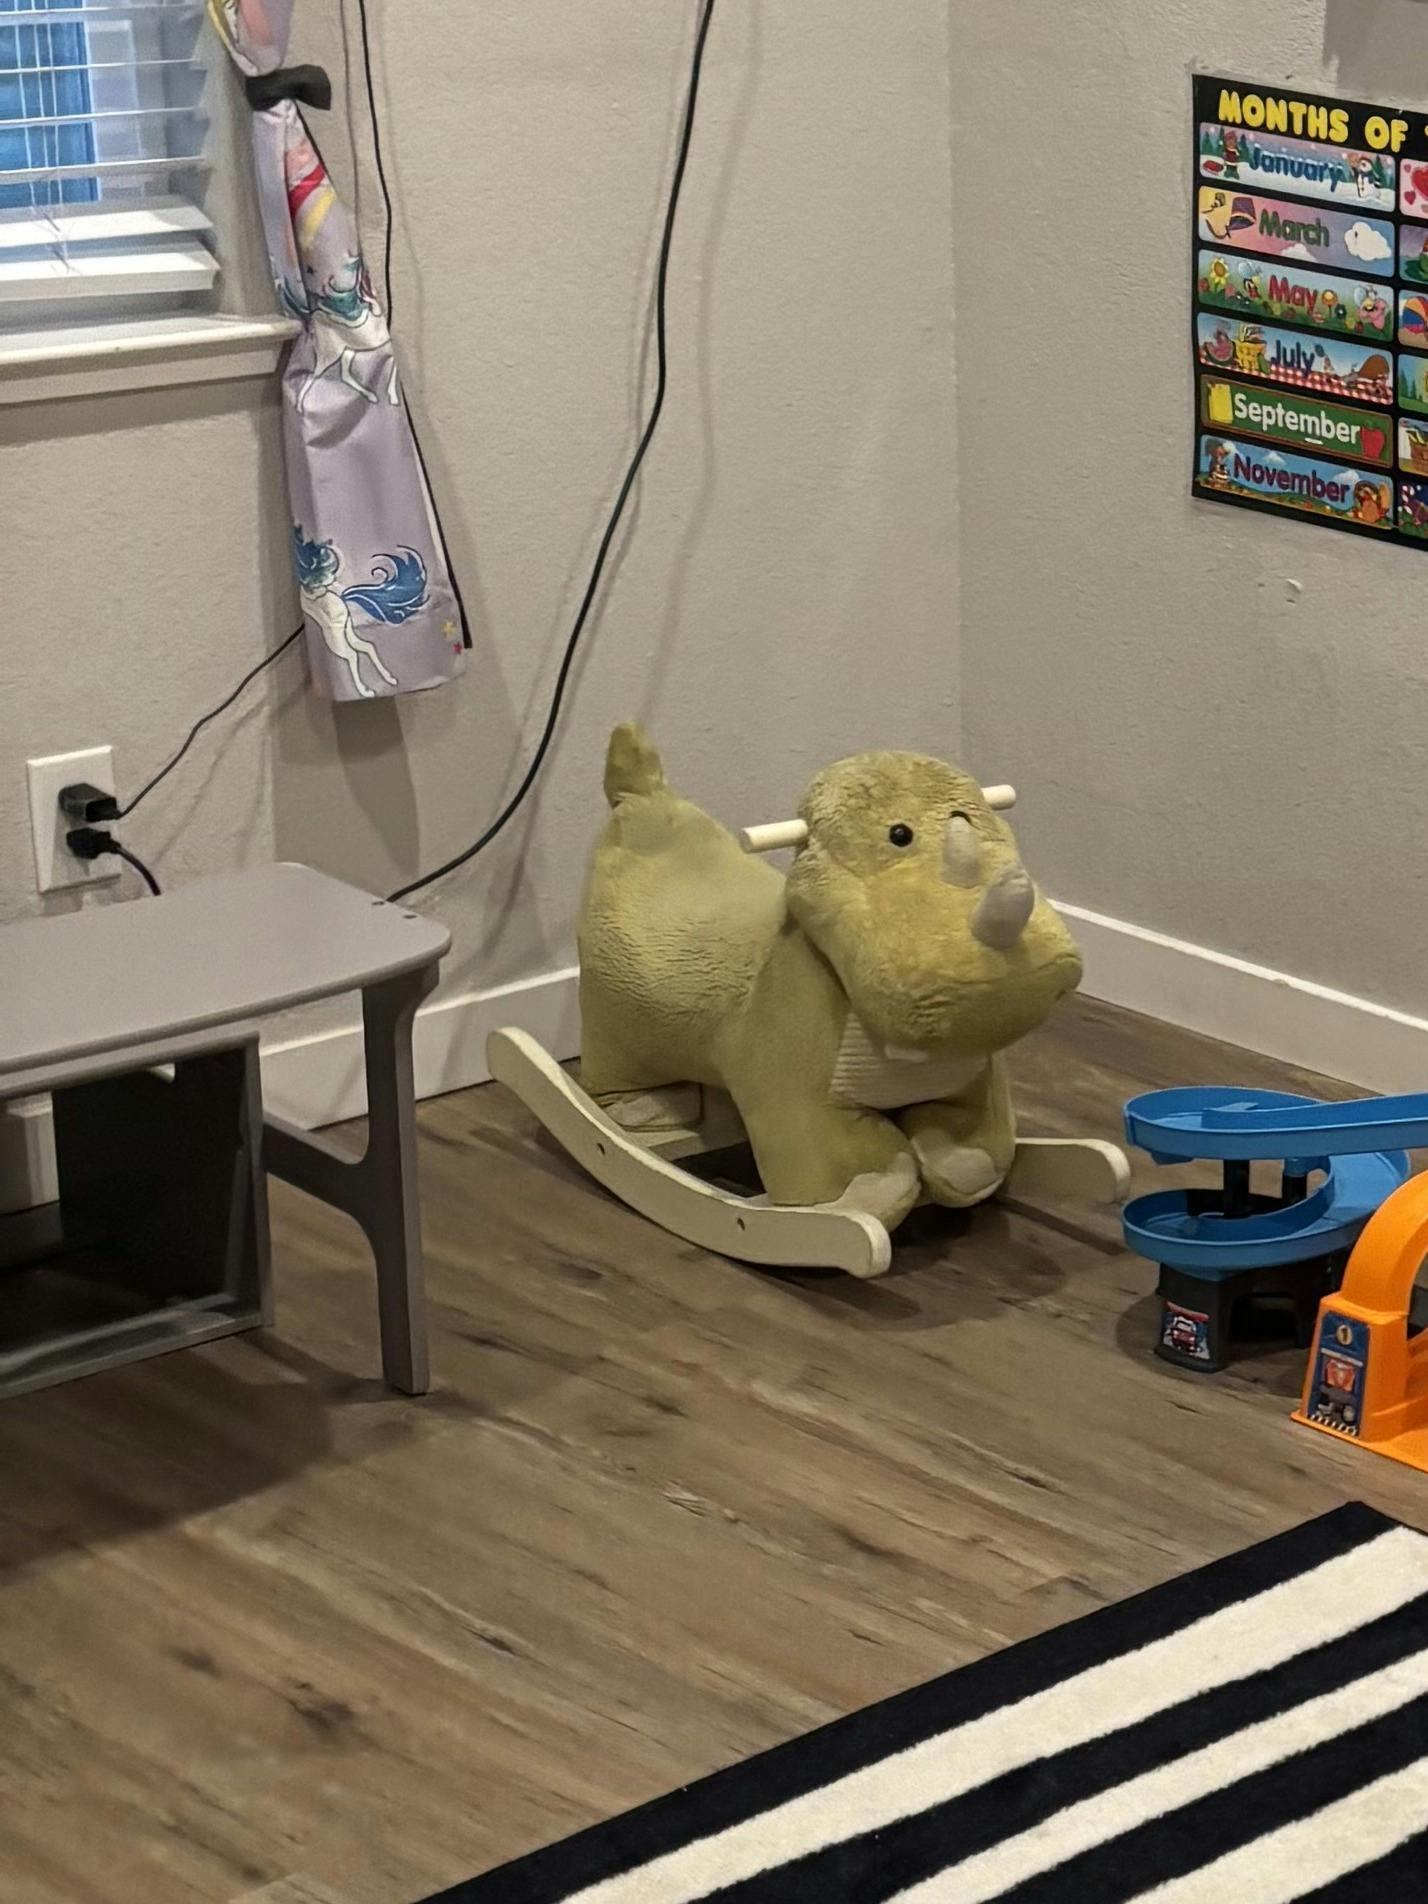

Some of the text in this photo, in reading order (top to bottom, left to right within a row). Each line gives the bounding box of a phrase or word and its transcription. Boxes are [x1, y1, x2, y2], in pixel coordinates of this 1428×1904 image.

[1218, 89, 1349, 143] MONTHS
[1365, 116, 1408, 152] OF
[1249, 147, 1344, 191] January
[1260, 209, 1329, 246] March
[1269, 275, 1319, 310] May
[1269, 339, 1316, 377] July
[1234, 394, 1361, 443] September
[1233, 453, 1350, 504] November
